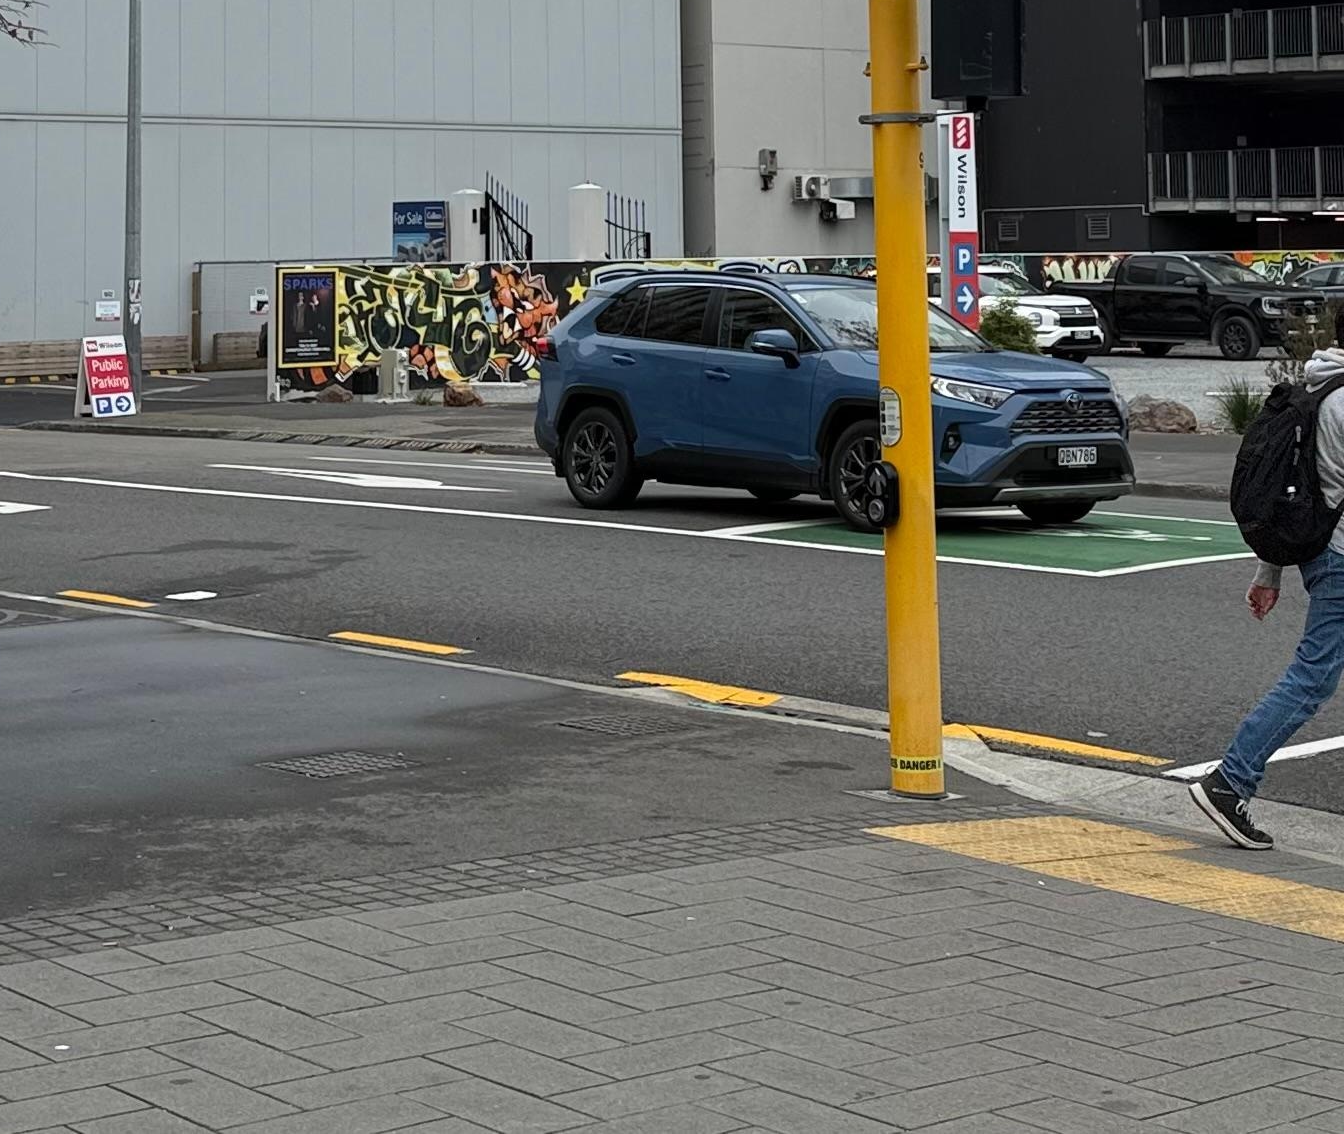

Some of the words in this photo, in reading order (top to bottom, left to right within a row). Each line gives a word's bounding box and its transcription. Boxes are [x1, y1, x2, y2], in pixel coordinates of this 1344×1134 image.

[957, 154, 968, 219] Wilson
[394, 211, 405, 226] For
[407, 211, 423, 225] Sale
[959, 249, 971, 271] P
[284, 277, 333, 290] SPARKS
[91, 358, 123, 372] Public
[91, 375, 129, 389] Parking
[99, 399, 109, 412] P
[899, 759, 937, 770] DANGER
